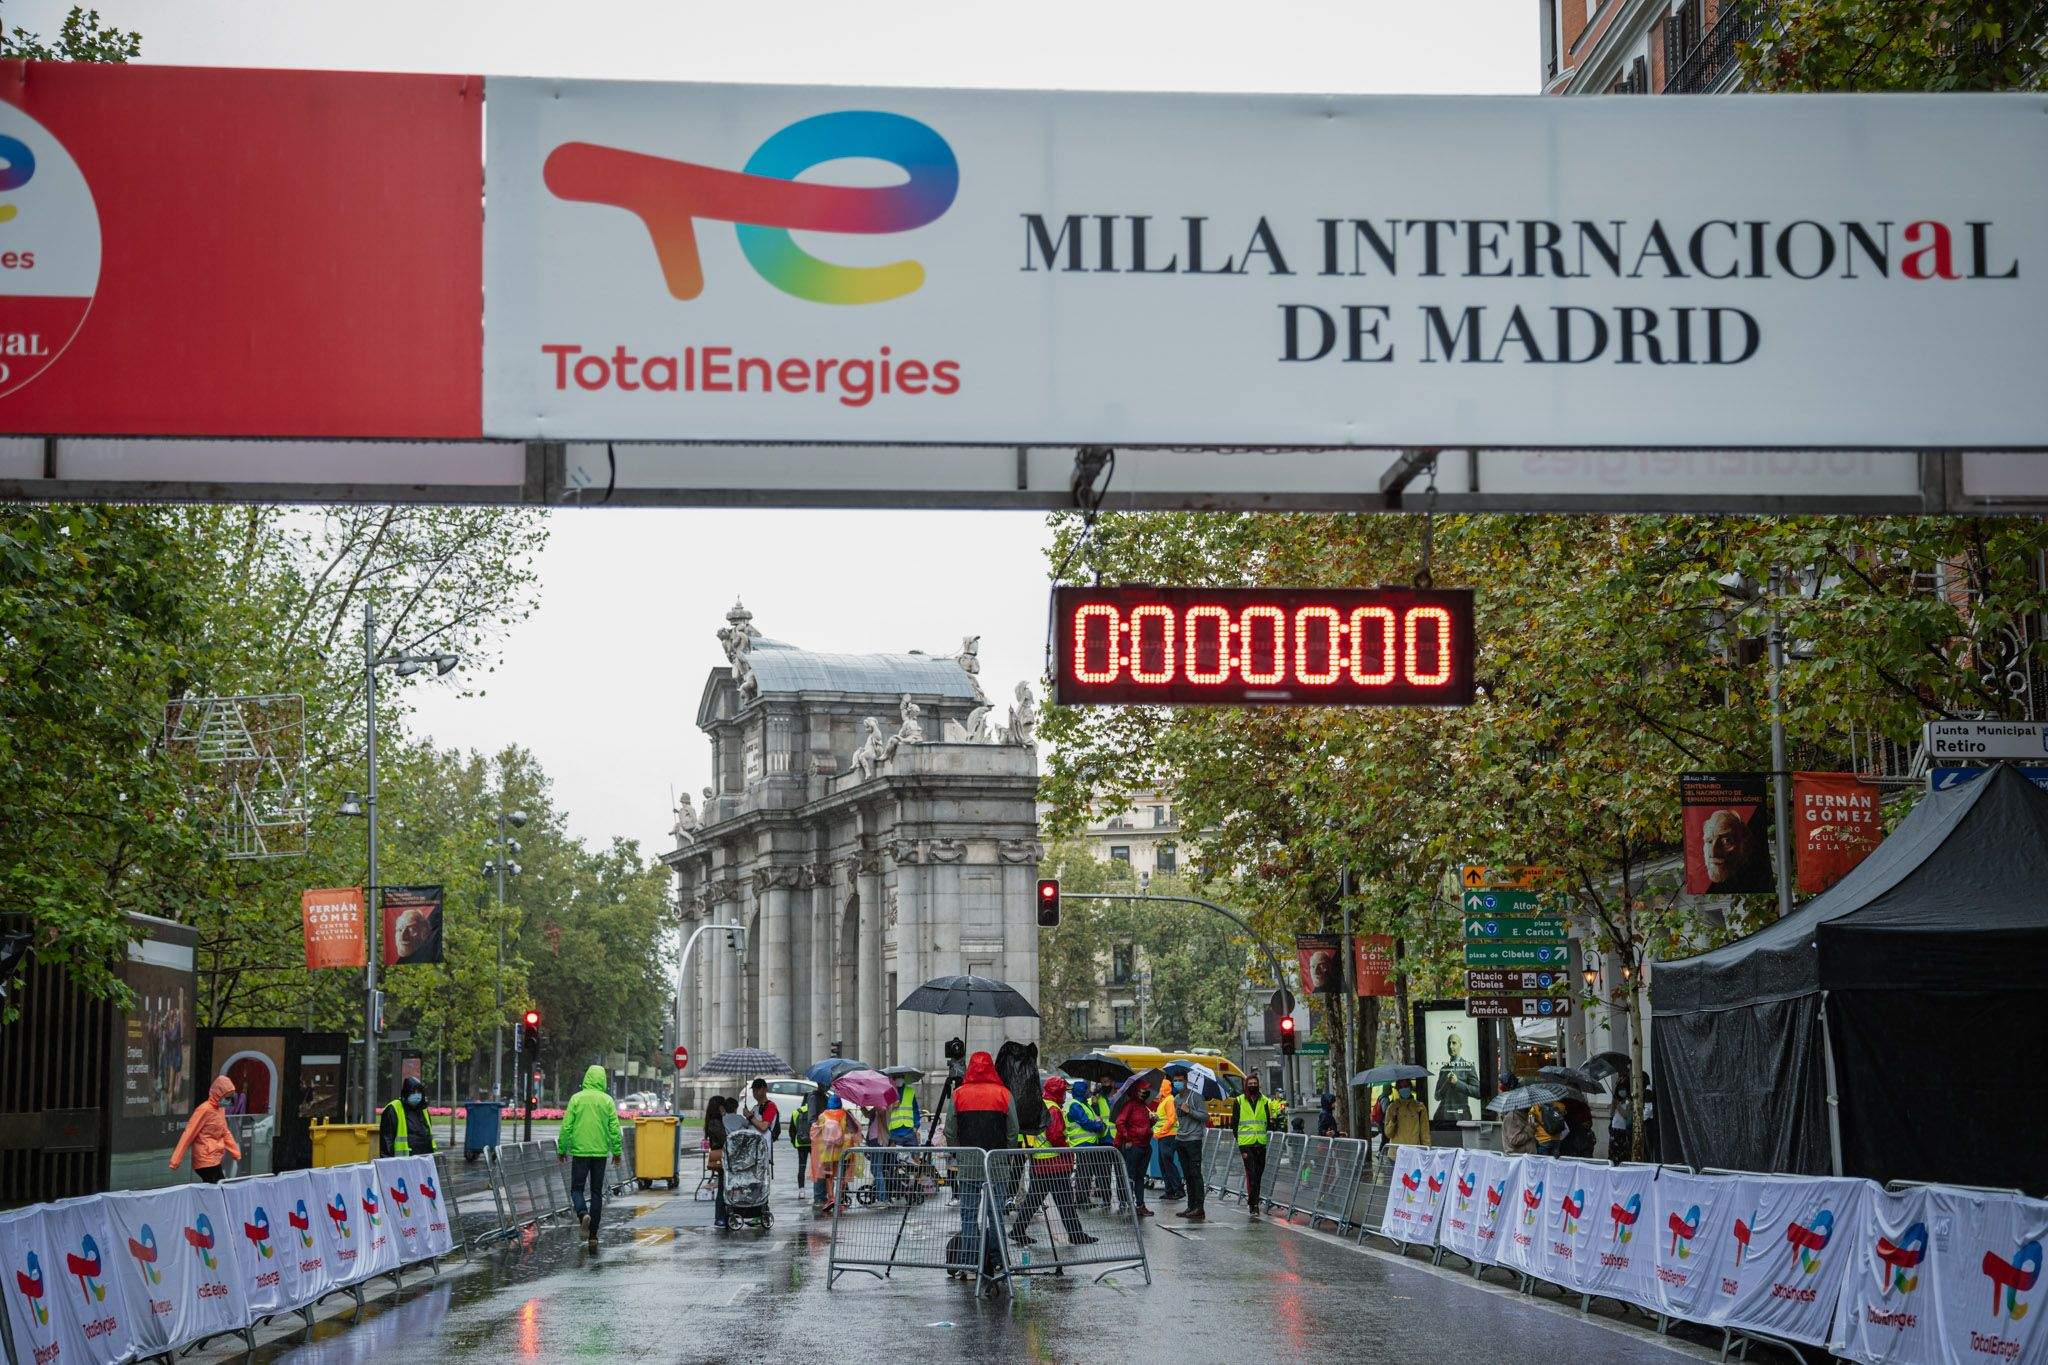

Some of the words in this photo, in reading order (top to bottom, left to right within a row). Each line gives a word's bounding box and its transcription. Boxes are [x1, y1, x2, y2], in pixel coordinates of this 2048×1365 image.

[1020, 213, 1297, 275] MILLA
[1278, 304, 1395, 363] DE
[1418, 303, 1761, 365] MADRID
[542, 344, 961, 407] TotalEnergies
[1074, 604, 1452, 686] 0:00:00:00
[1936, 725, 1970, 736] Junta
[1976, 725, 2037, 738] Municipal
[1936, 739, 1986, 753] Retiro
[1805, 792, 1872, 808] FERNÁN
[1806, 807, 1872, 823] GÓMEZ
[1826, 843, 1840, 851] LA
[308, 901, 358, 914] FERNÁN
[309, 912, 359, 924] GÓMEZ
[1512, 928, 1521, 936] E.
[1525, 927, 1555, 937] Carlos
[1501, 949, 1535, 958] Cibeles
[1470, 972, 1503, 981] Palacio
[1508, 972, 1519, 980] de
[1470, 980, 1505, 989] Cibeles
[1472, 1004, 1508, 1015] América
